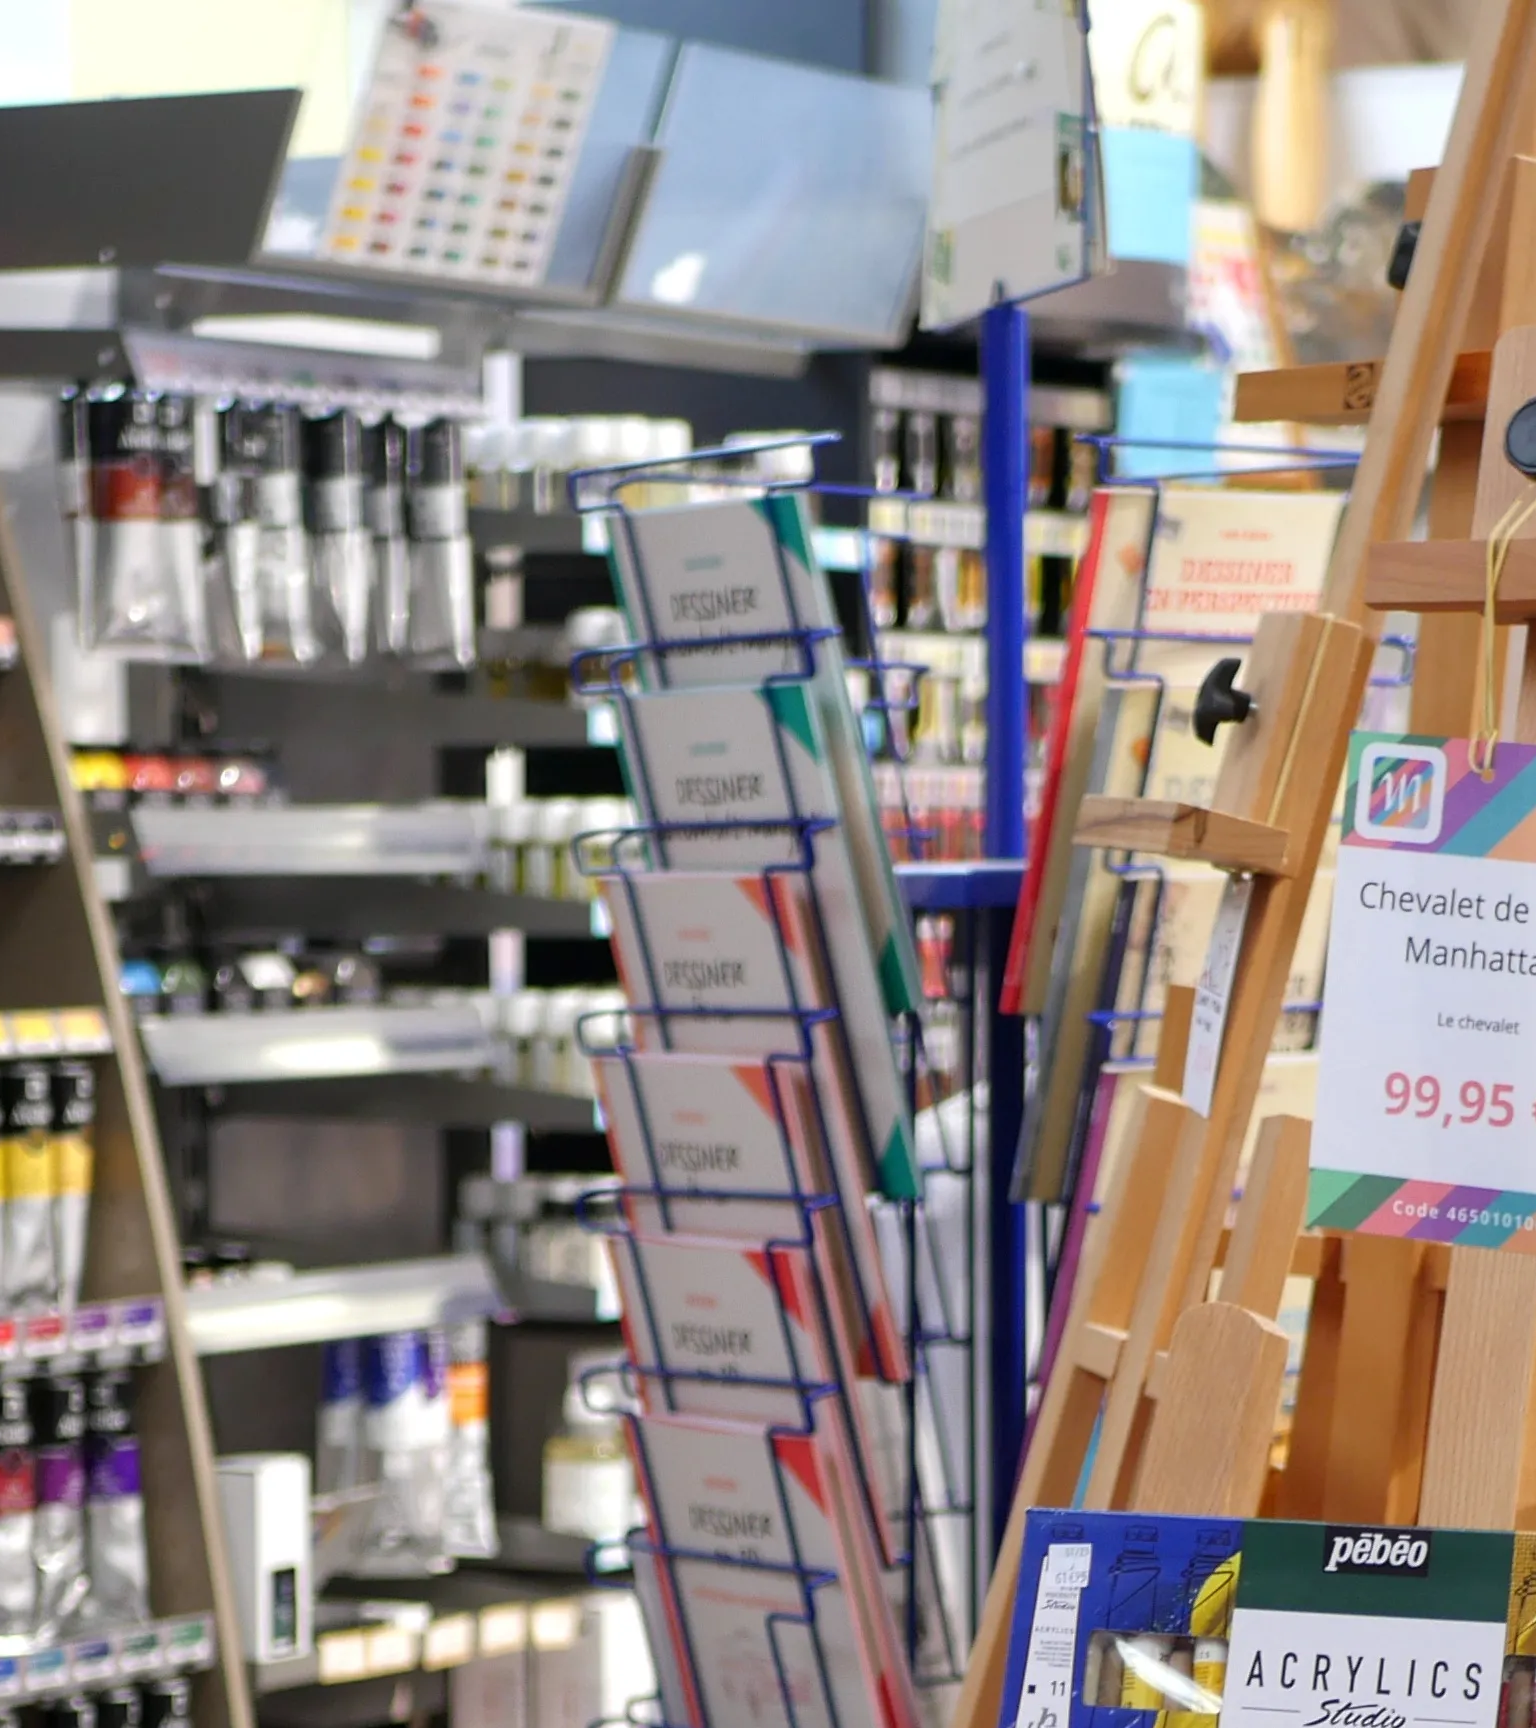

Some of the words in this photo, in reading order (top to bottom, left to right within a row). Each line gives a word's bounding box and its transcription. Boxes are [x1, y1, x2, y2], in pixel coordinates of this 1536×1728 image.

[671, 586, 761, 623] DESSINER
[676, 773, 764, 807] DESSINER
[1359, 882, 1484, 921] Chevalet
[1494, 893, 1530, 924] de
[664, 961, 747, 992] DESSINER
[1437, 1013, 1455, 1029] Le
[1457, 1014, 1520, 1035] chevalet
[1384, 1072, 1516, 1129] 99,95
[1392, 1200, 1439, 1221] Code
[672, 1324, 752, 1357] DESSINER
[688, 1506, 773, 1542] DESSINER
[1050, 1680, 1066, 1696] 11
[1245, 1650, 1483, 1701] ACRYLICS
